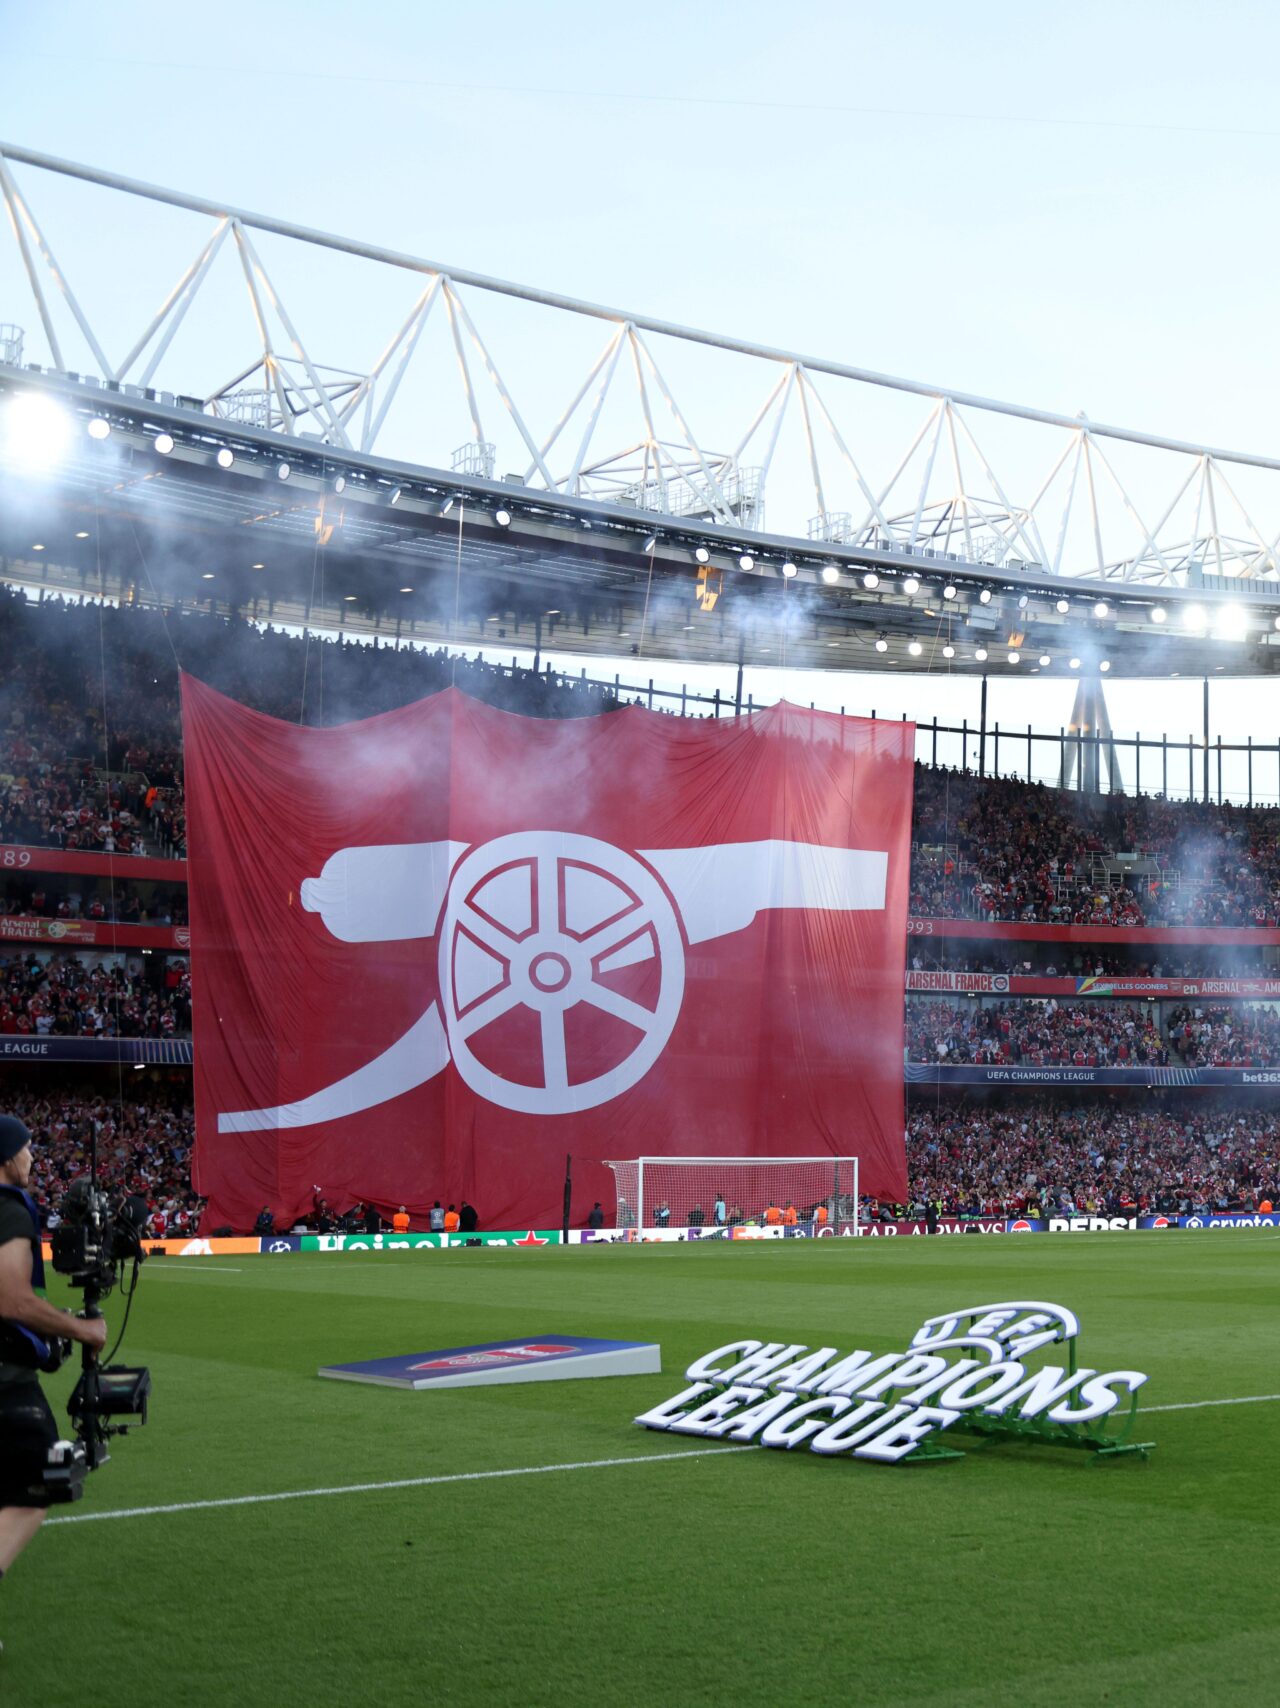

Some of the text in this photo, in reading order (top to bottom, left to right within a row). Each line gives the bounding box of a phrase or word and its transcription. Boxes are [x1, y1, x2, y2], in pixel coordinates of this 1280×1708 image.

[1, 918, 40, 928] Arsenal
[908, 972, 993, 991] ARSENAL FRANCE
[1202, 981, 1240, 993] ARSENAL
[0, 1042, 48, 1054] EAGUE
[987, 1071, 1095, 1080] UEFA CHAMPIONS LEAGUE
[911, 1309, 1062, 1361] UEFA
[685, 1339, 1152, 1423] CHAMPIONS
[634, 1381, 962, 1462] LEAGUE
